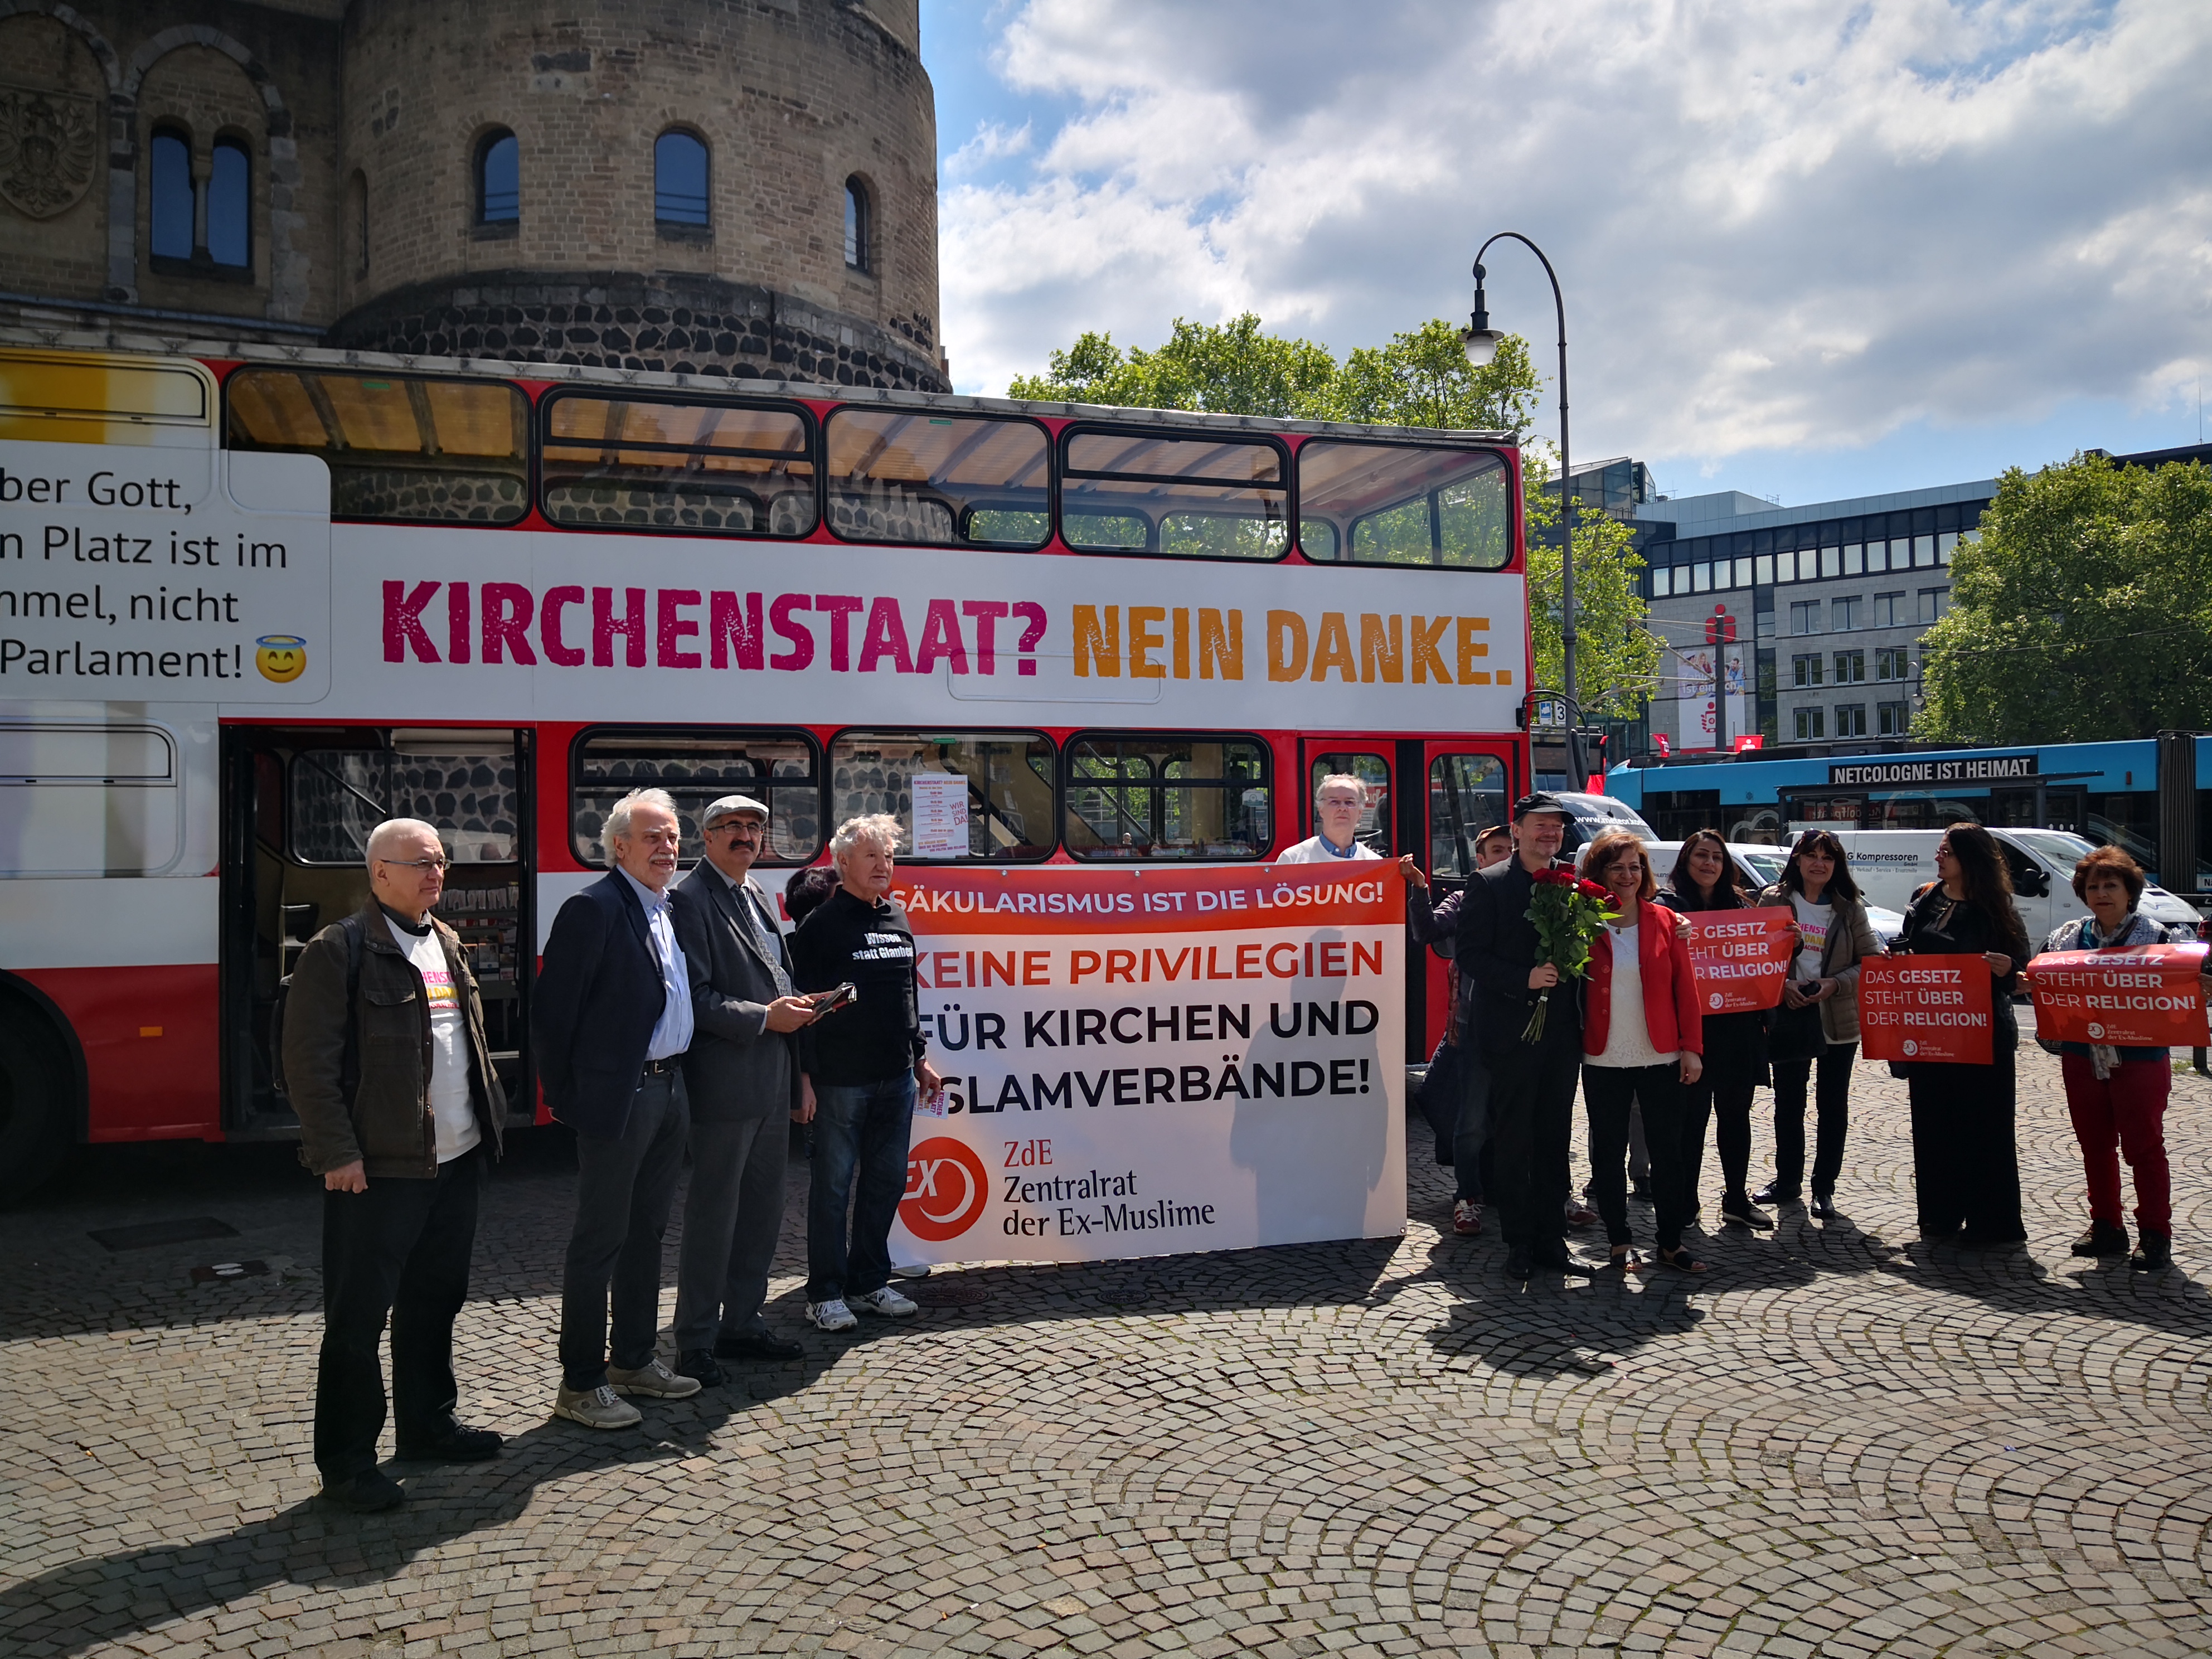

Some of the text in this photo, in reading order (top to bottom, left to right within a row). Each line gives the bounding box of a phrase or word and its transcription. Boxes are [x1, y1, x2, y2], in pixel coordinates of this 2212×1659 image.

[88, 472, 192, 515] Gott,
[45, 526, 152, 563] Platz
[171, 531, 220, 566] ist
[238, 533, 287, 568] im
[131, 586, 239, 623] nicht
[382, 580, 1512, 686] KIRCHENSTAAT? NEIN DANKE.
[1, 639, 241, 678] Parlament!
[1557, 706, 1565, 720] 3
[1835, 759, 2031, 784] NETCOLOGNE IST HEIMAT
[949, 801, 964, 810] WIR
[952, 808, 966, 817] SIND
[954, 814, 969, 826] DA!
[1856, 852, 1918, 862] Kompressoren
[889, 881, 1384, 914] SÄKULARISMUS IST DIE LÖSUNG!
[864, 933, 901, 945] Wissen
[1704, 921, 1766, 939] GESETZ
[852, 948, 879, 960] statt
[1688, 942, 1769, 960] EHT ÜBER
[2039, 954, 2165, 966] DAS GESETZ
[1070, 940, 1382, 985] PRIVILEGIEN
[1709, 960, 1787, 979] RELIGION!
[1866, 970, 1962, 984] DAS GESETZ
[2035, 970, 2163, 988] STEHT ÜBER
[1865, 988, 1964, 1005] STEHT ÜBER
[2040, 992, 2196, 1010] DER RELIGION!
[1025, 1003, 1250, 1049] KIRCHEN
[1269, 1000, 1380, 1039] UND
[1867, 1012, 1987, 1026] DER RELIGION!
[940, 1054, 1370, 1115] SLAMVERBÄNDE!
[1004, 1139, 1052, 1167] ZdE
[1003, 1170, 1138, 1202] Zentralrat
[1003, 1200, 1215, 1236] der Ex-Muslime
